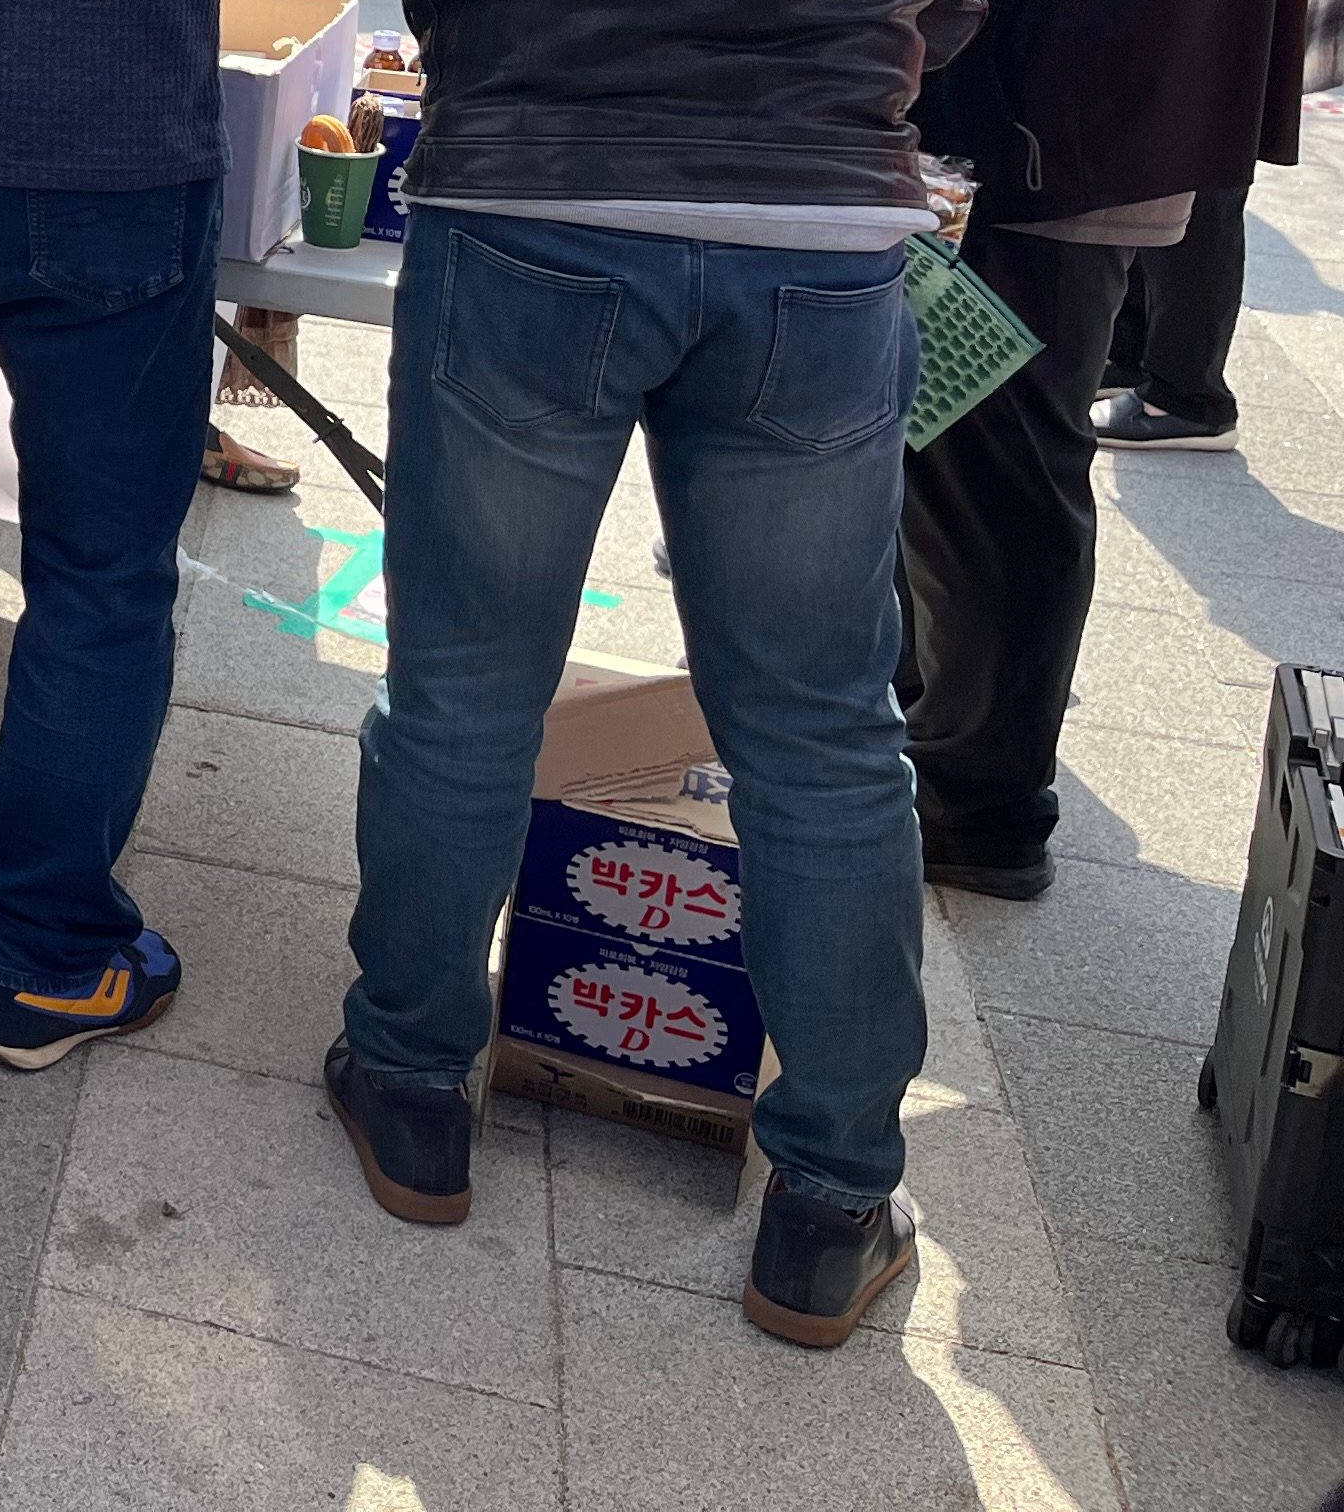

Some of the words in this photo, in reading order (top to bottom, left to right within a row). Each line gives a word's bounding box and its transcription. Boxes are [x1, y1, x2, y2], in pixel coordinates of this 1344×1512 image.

[592, 856, 728, 920] 박카스
[638, 904, 671, 931] D
[572, 977, 707, 1042] 박카스
[618, 1025, 651, 1053] D
